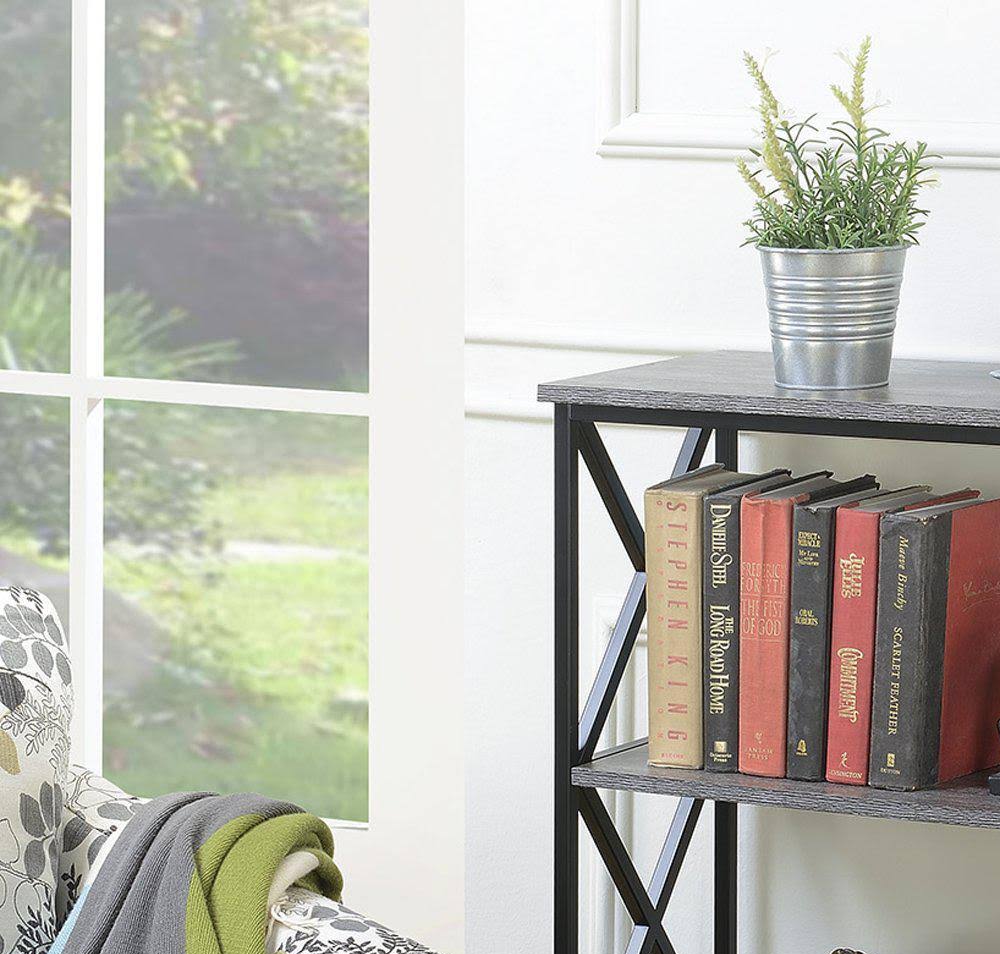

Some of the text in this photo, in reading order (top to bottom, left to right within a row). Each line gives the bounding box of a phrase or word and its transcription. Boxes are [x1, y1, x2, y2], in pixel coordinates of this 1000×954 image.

[666, 501, 688, 630] STEPHEN
[840, 558, 852, 599] ELLIS
[849, 553, 865, 597] JULIE
[894, 535, 909, 611] Maeve Binchy
[724, 615, 735, 635] THE
[742, 617, 782, 636] OF GOD
[763, 600, 783, 618] FIST
[708, 604, 731, 715] LONG ROAD HOME
[887, 626, 903, 736] SCARLET FEATHER
[667, 655, 688, 740] KING
